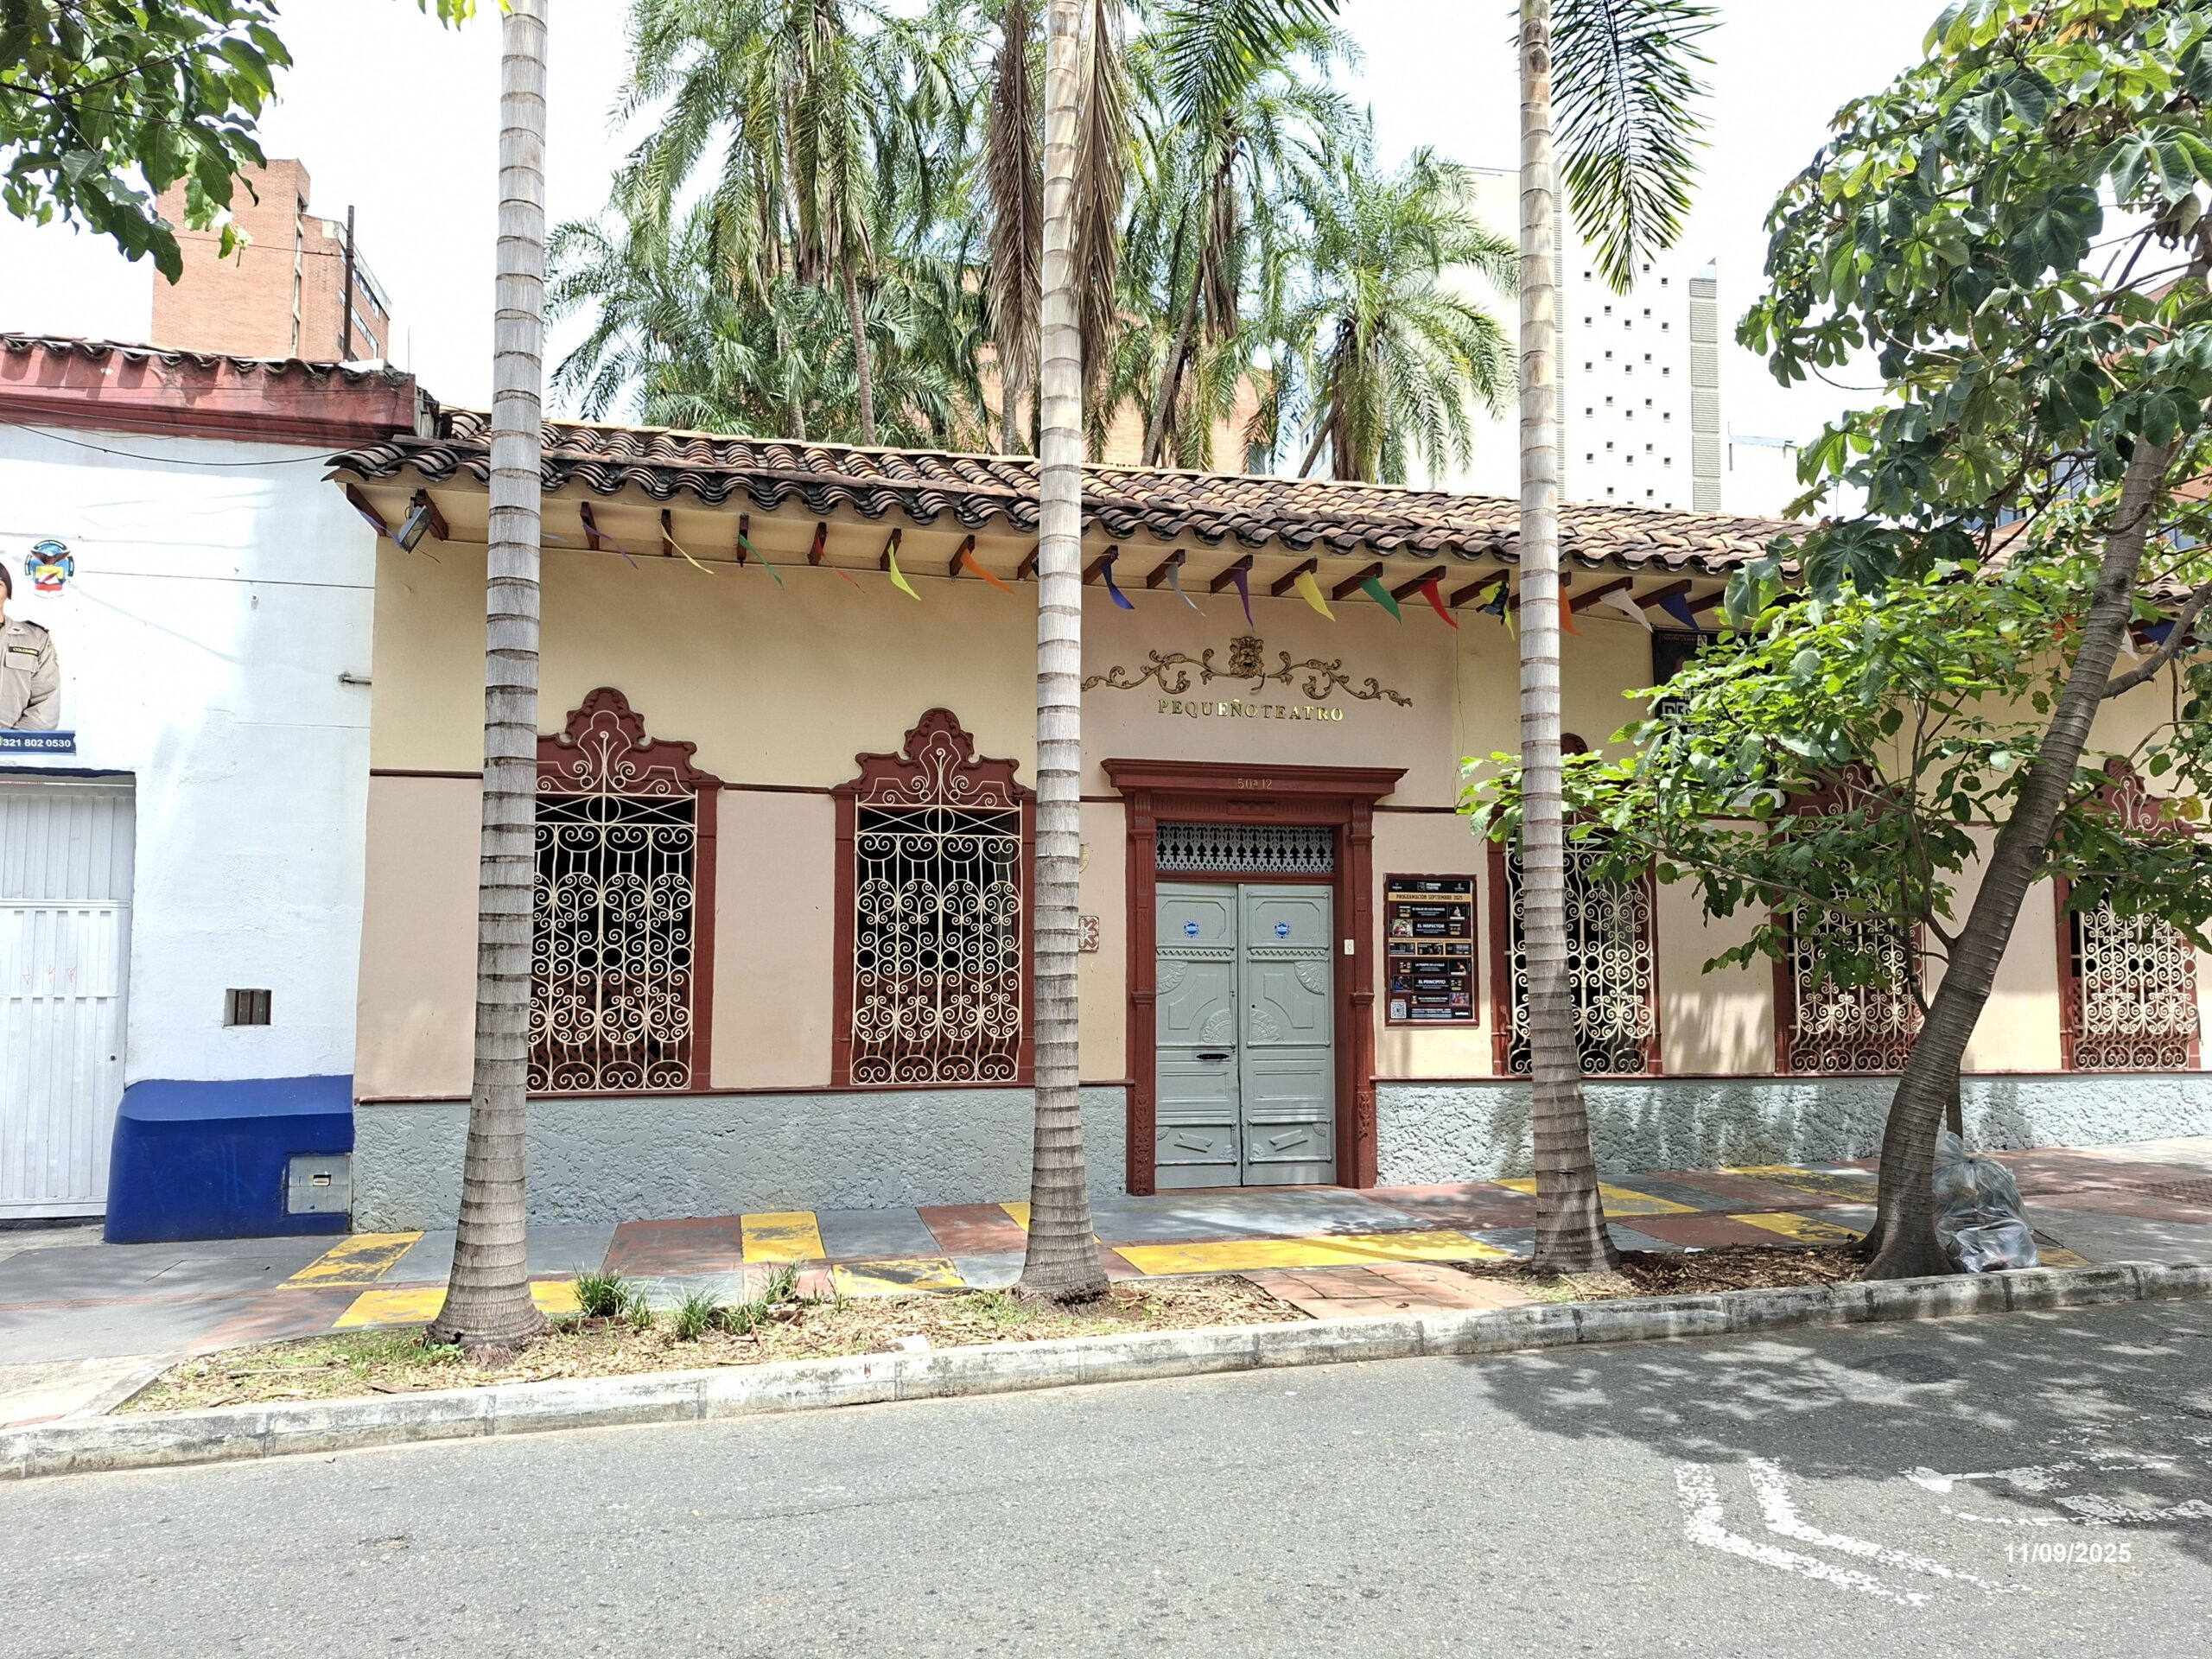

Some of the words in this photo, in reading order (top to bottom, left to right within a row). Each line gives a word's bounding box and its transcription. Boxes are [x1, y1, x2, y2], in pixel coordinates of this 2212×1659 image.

[3, 738, 22, 747] 321
[24, 738, 44, 747] 802
[46, 739, 71, 747] 0530
